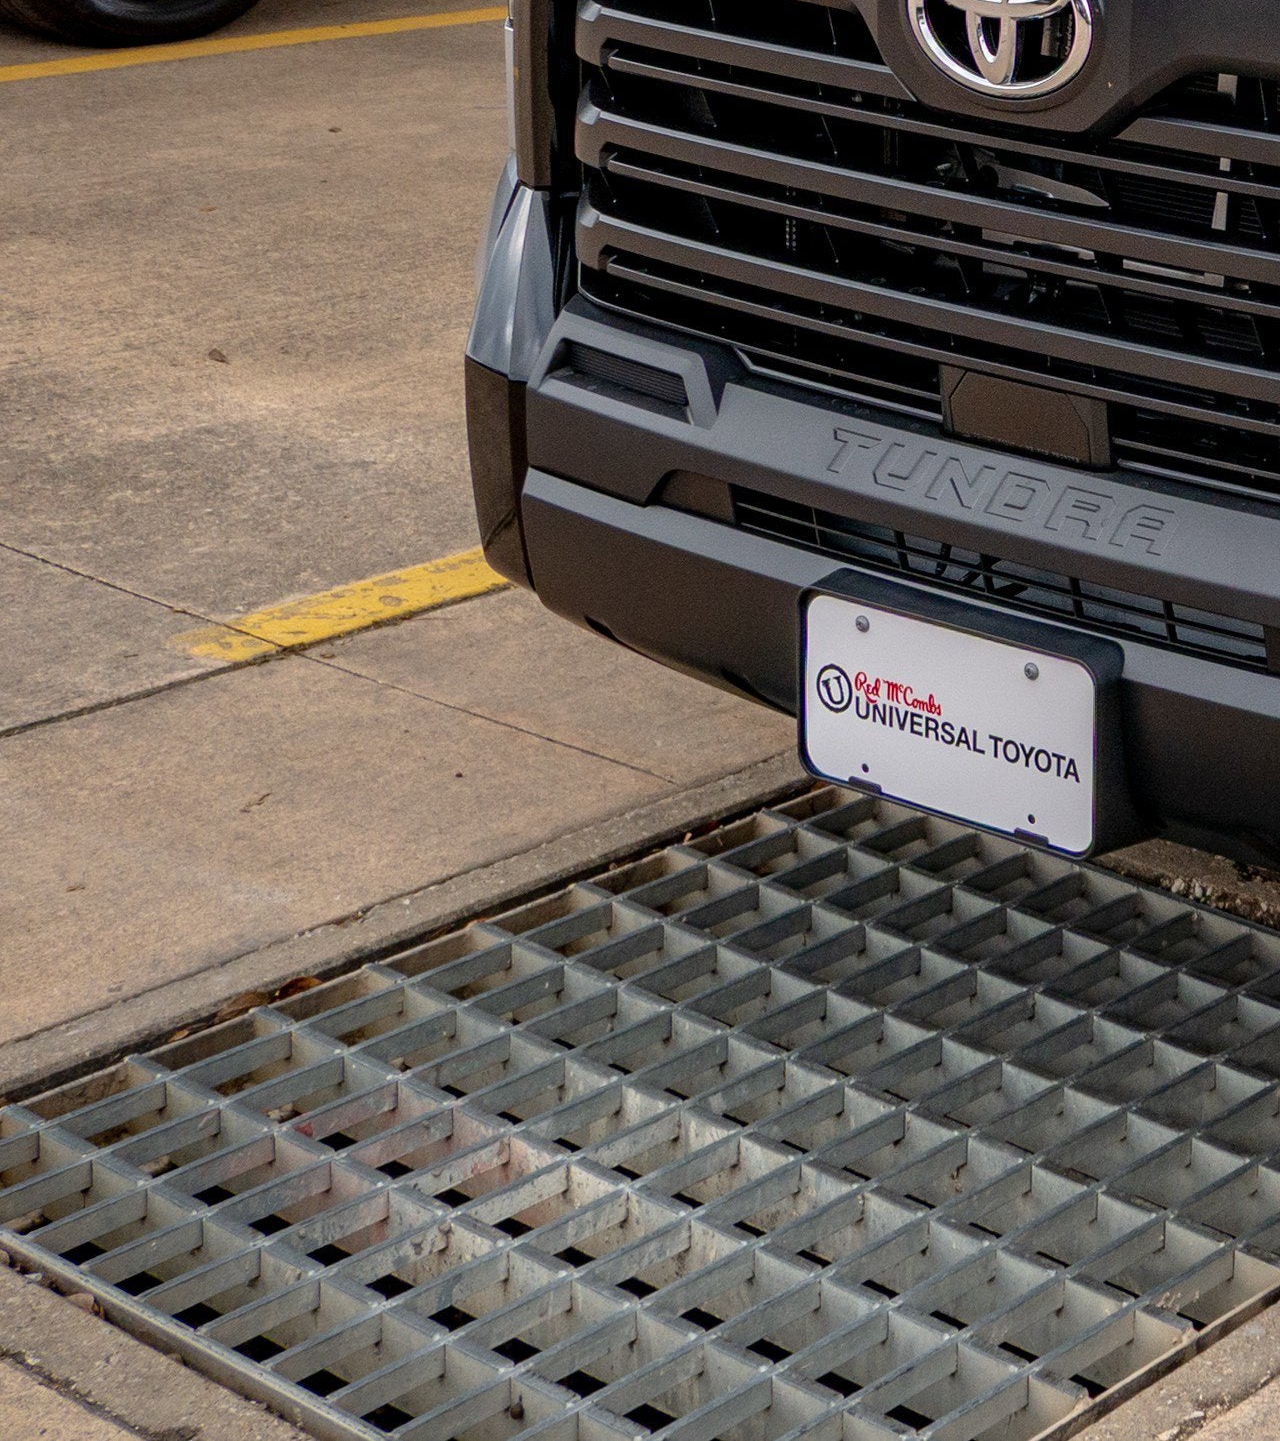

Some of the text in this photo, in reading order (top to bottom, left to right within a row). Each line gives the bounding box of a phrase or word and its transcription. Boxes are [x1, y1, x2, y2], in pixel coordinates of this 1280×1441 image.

[826, 427, 1180, 556] TUNDRA
[854, 671, 880, 704] Red
[855, 695, 1081, 783] UNIVERSAL TOYOTA
